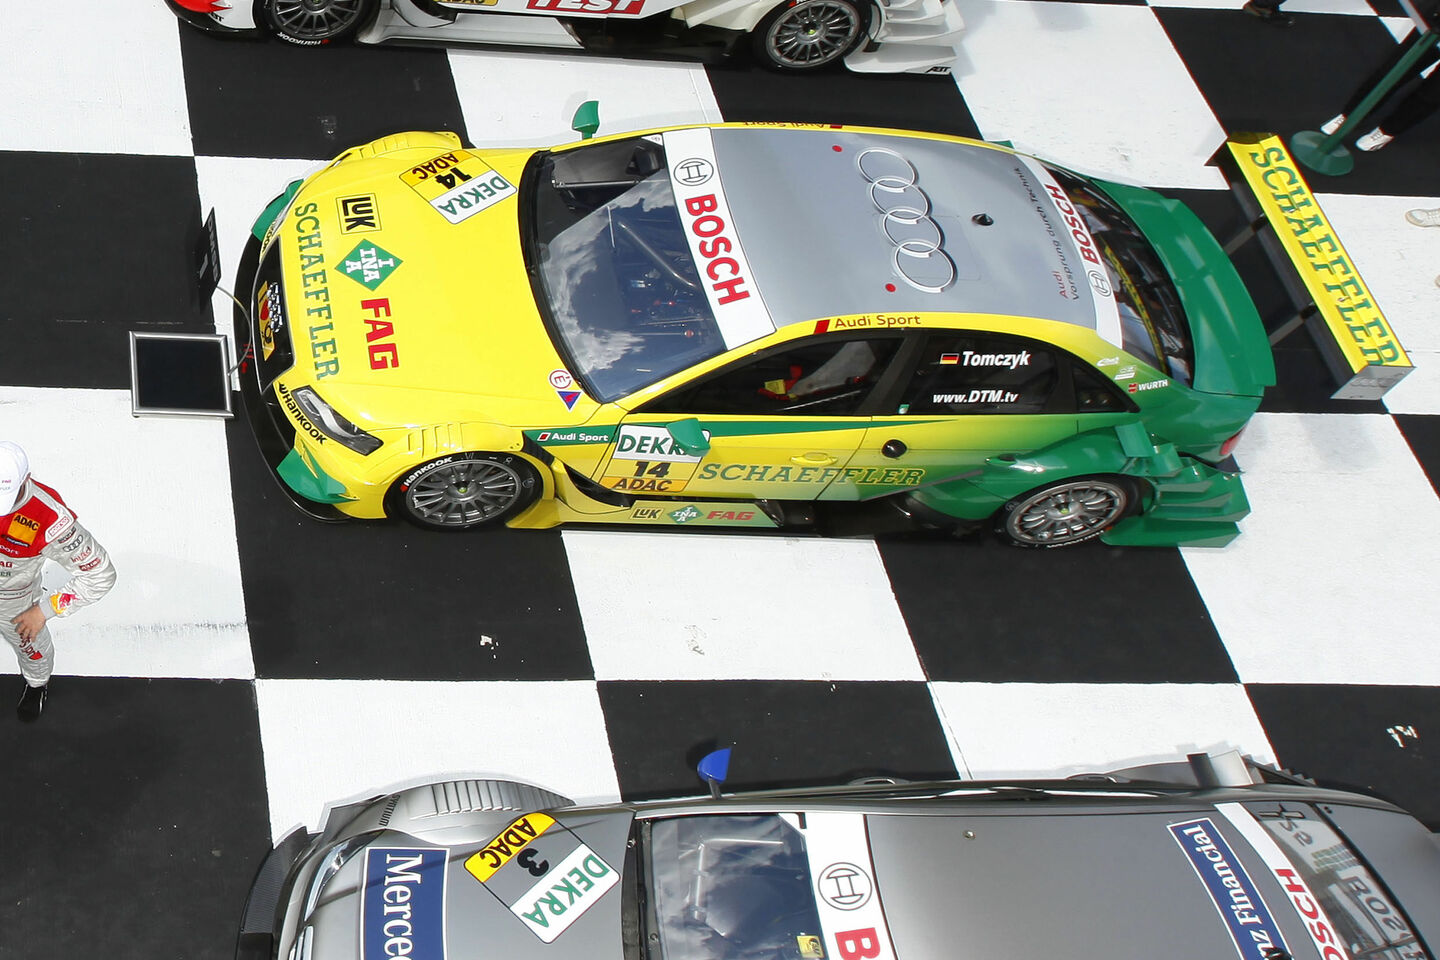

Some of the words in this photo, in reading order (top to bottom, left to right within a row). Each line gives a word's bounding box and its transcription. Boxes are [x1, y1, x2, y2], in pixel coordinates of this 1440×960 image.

[411, 152, 460, 181] ADAC
[436, 166, 471, 189] 14
[437, 176, 511, 217] DEKRA
[1044, 184, 1101, 266] BOSCH
[686, 193, 751, 306] BOSCH
[1249, 146, 1400, 366] SCHAEFFLER
[293, 201, 340, 381] SCHAEFFLER
[361, 298, 399, 371] FAG
[834, 316, 869, 330] Audi
[871, 314, 921, 331] Sport
[962, 349, 1031, 371] Tomczyk
[932, 389, 1019, 407] www.DTM.tv
[552, 431, 577, 441] Audi
[578, 433, 609, 444] Sport
[617, 434, 688, 457] DEKR
[634, 460, 671, 478] 14
[697, 463, 927, 487] SCHAEFFLER
[611, 477, 673, 492] ADAC
[14, 515, 40, 531] ADAC
[707, 510, 755, 521] FAG
[479, 816, 536, 870] ADAC
[517, 847, 551, 878] 3
[1181, 824, 1262, 927] Financial
[383, 853, 424, 960] Merce
[520, 856, 611, 929] DEKRA
